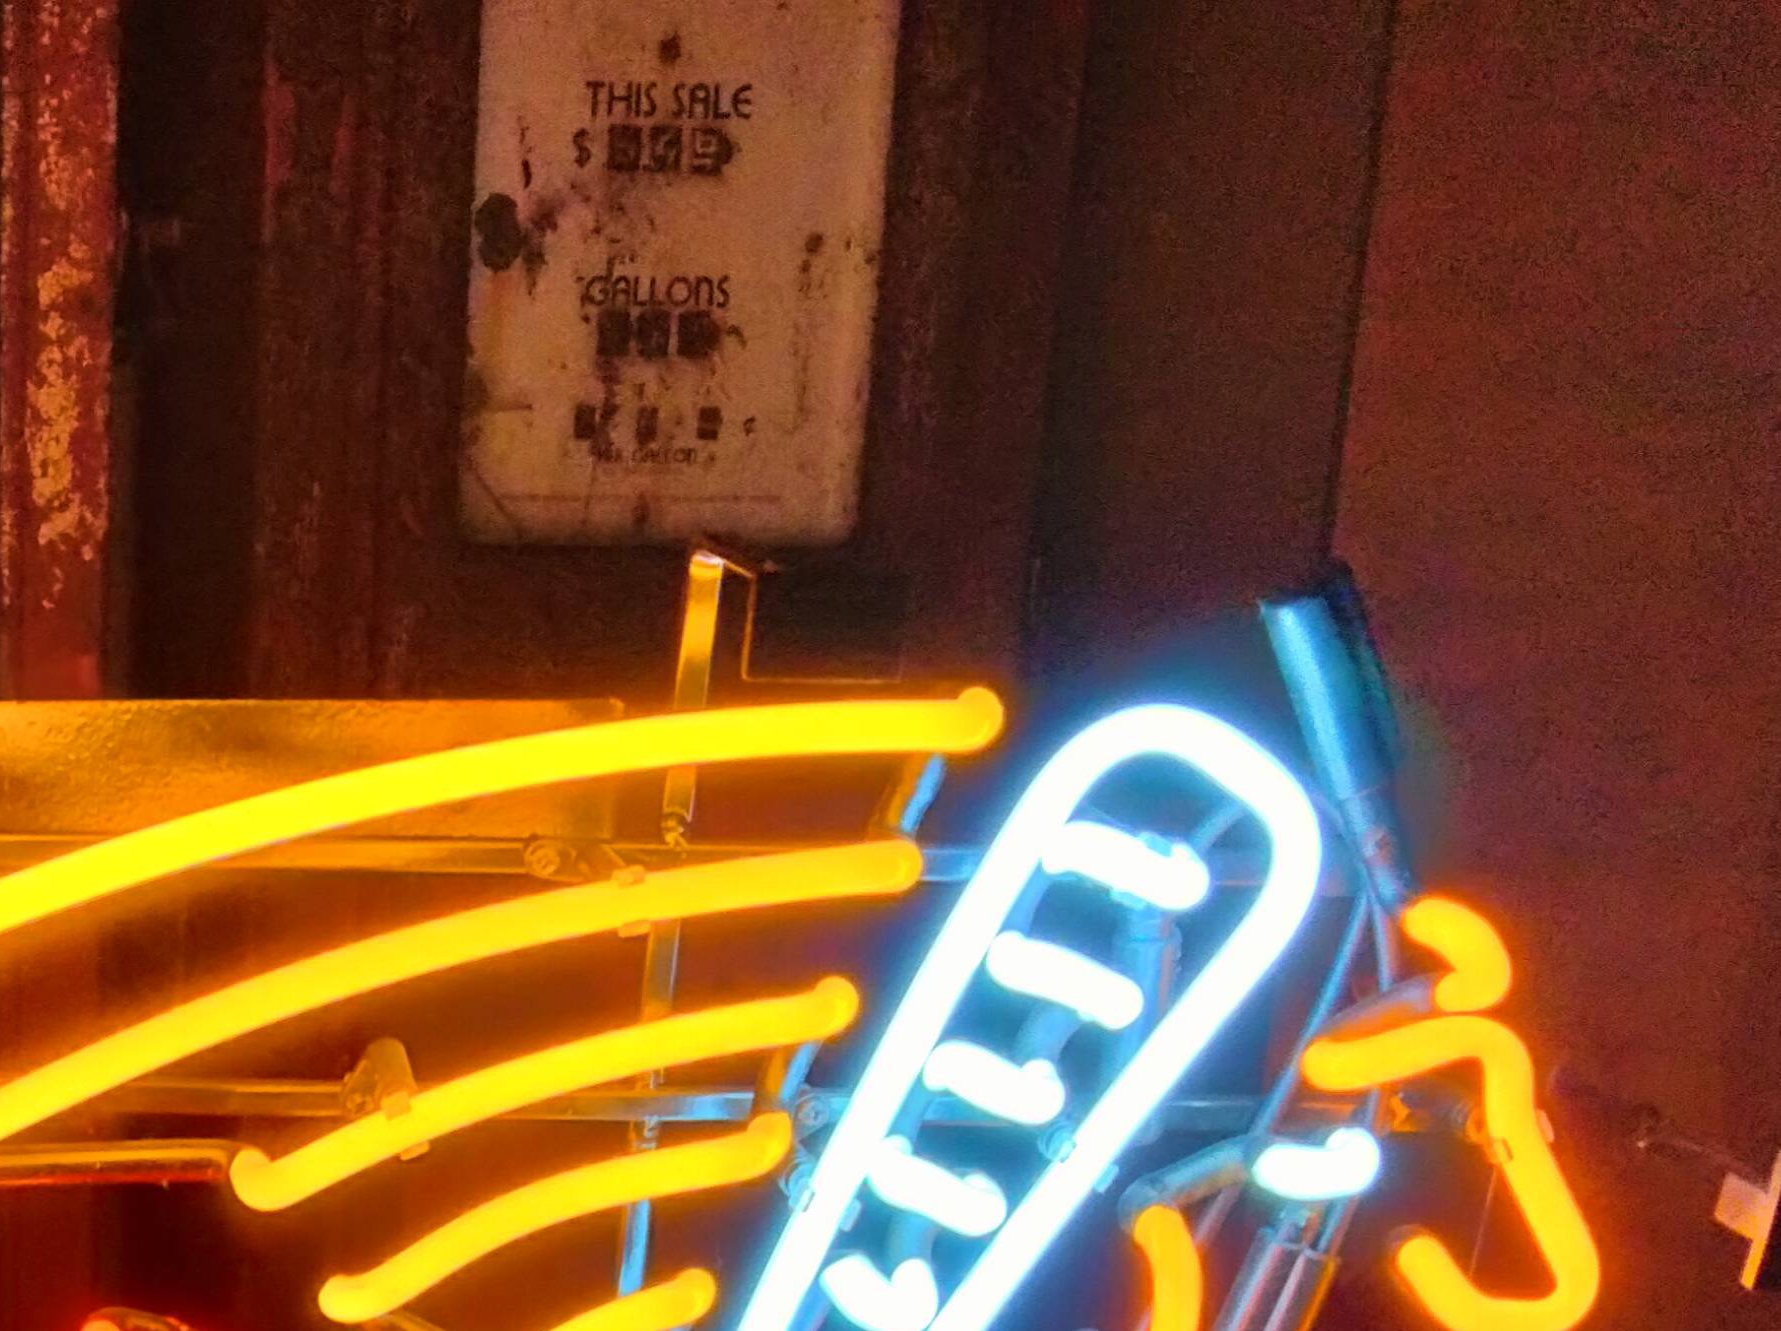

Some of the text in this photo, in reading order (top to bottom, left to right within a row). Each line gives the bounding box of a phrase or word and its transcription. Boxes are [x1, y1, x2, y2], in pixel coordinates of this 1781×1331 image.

[586, 80, 753, 120] THIS SALE
[584, 275, 730, 309] GALLONS
